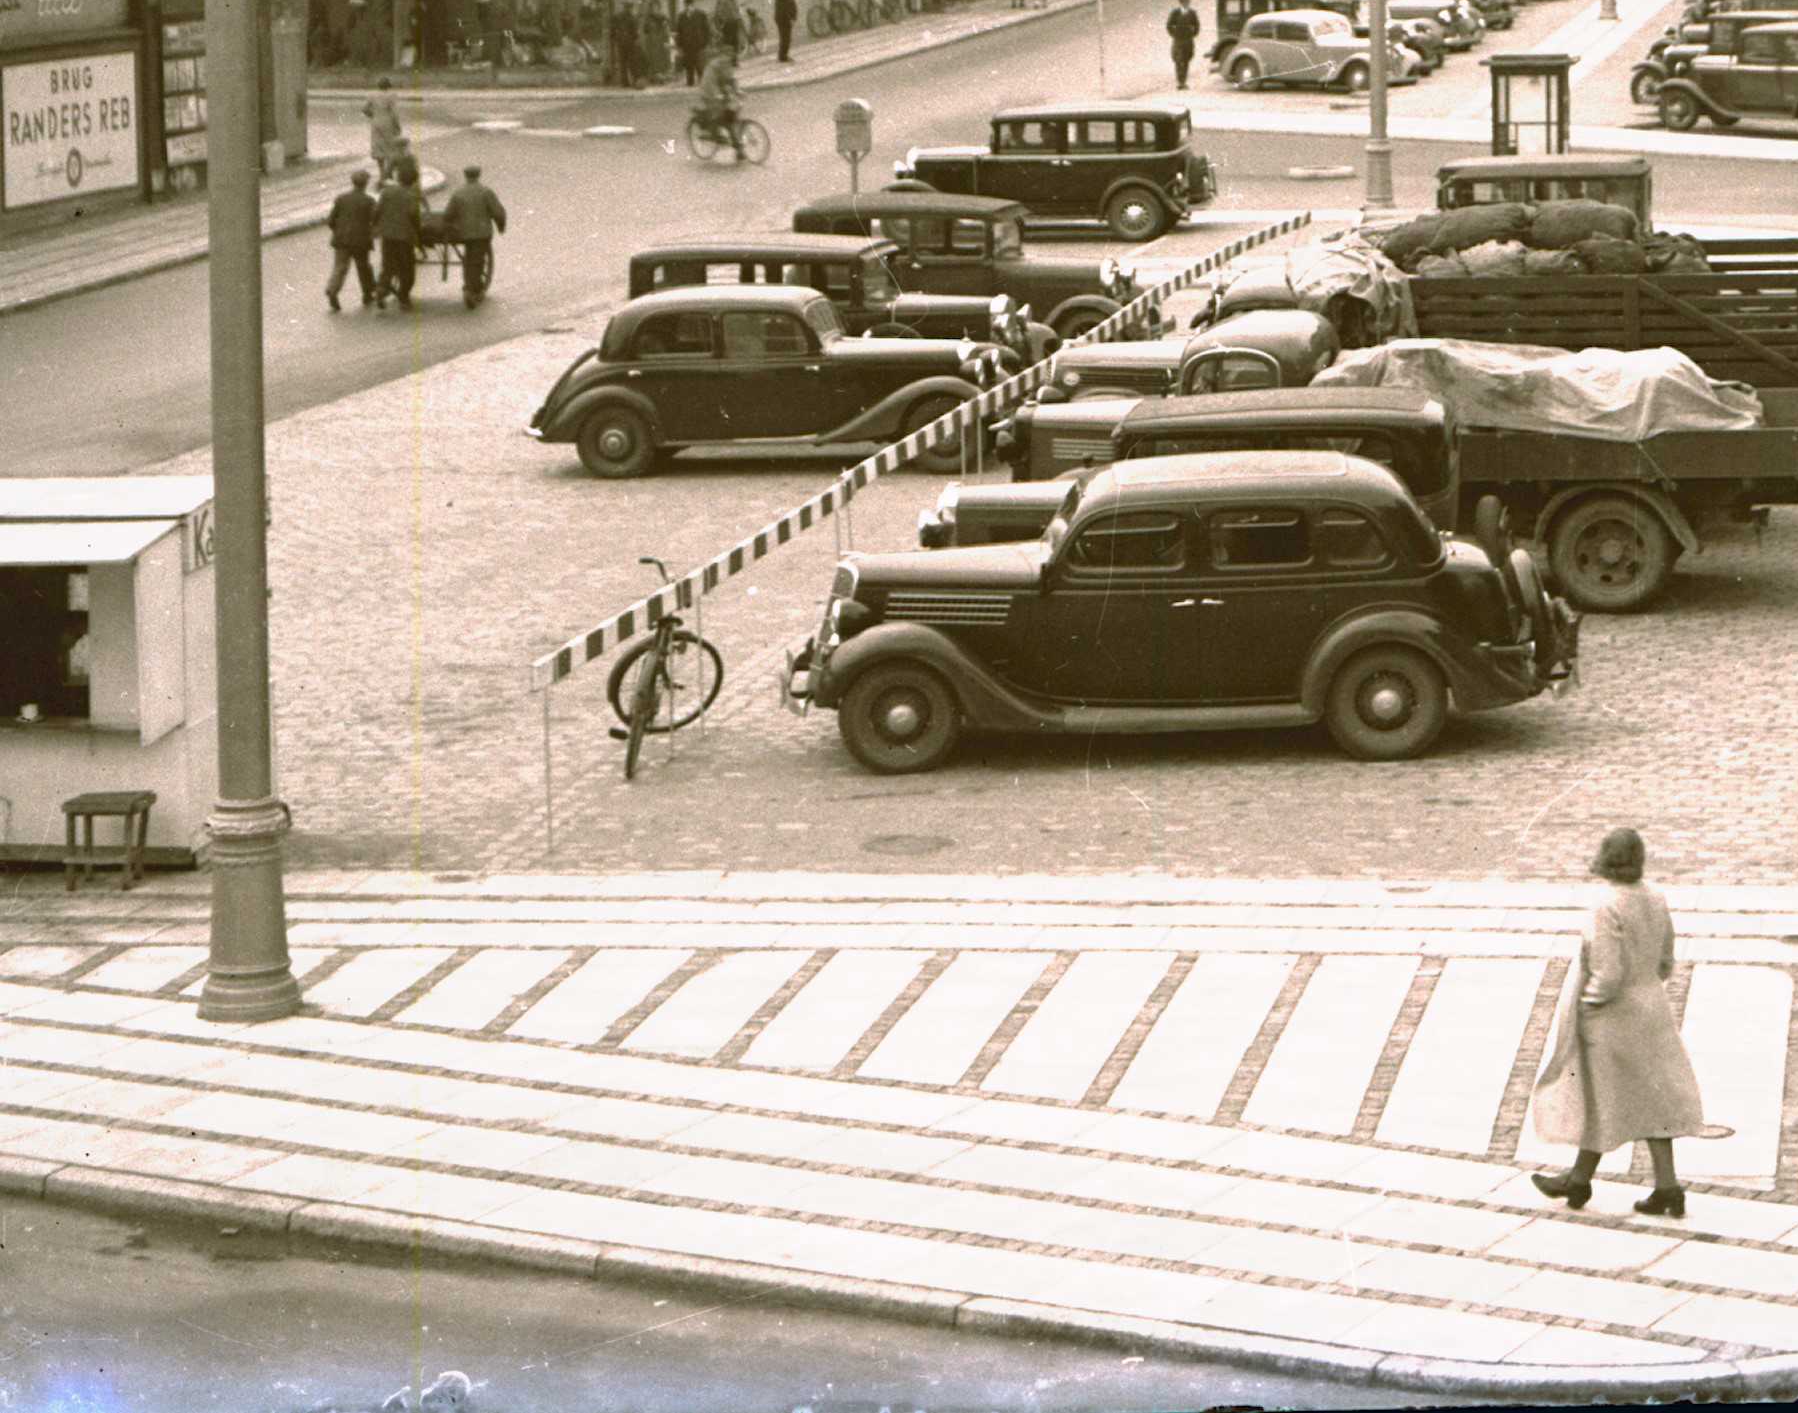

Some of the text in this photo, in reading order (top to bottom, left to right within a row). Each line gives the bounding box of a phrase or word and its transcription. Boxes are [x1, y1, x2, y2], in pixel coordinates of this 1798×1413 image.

[50, 66, 93, 93] BRUG
[10, 96, 131, 146] RANDERS REB
